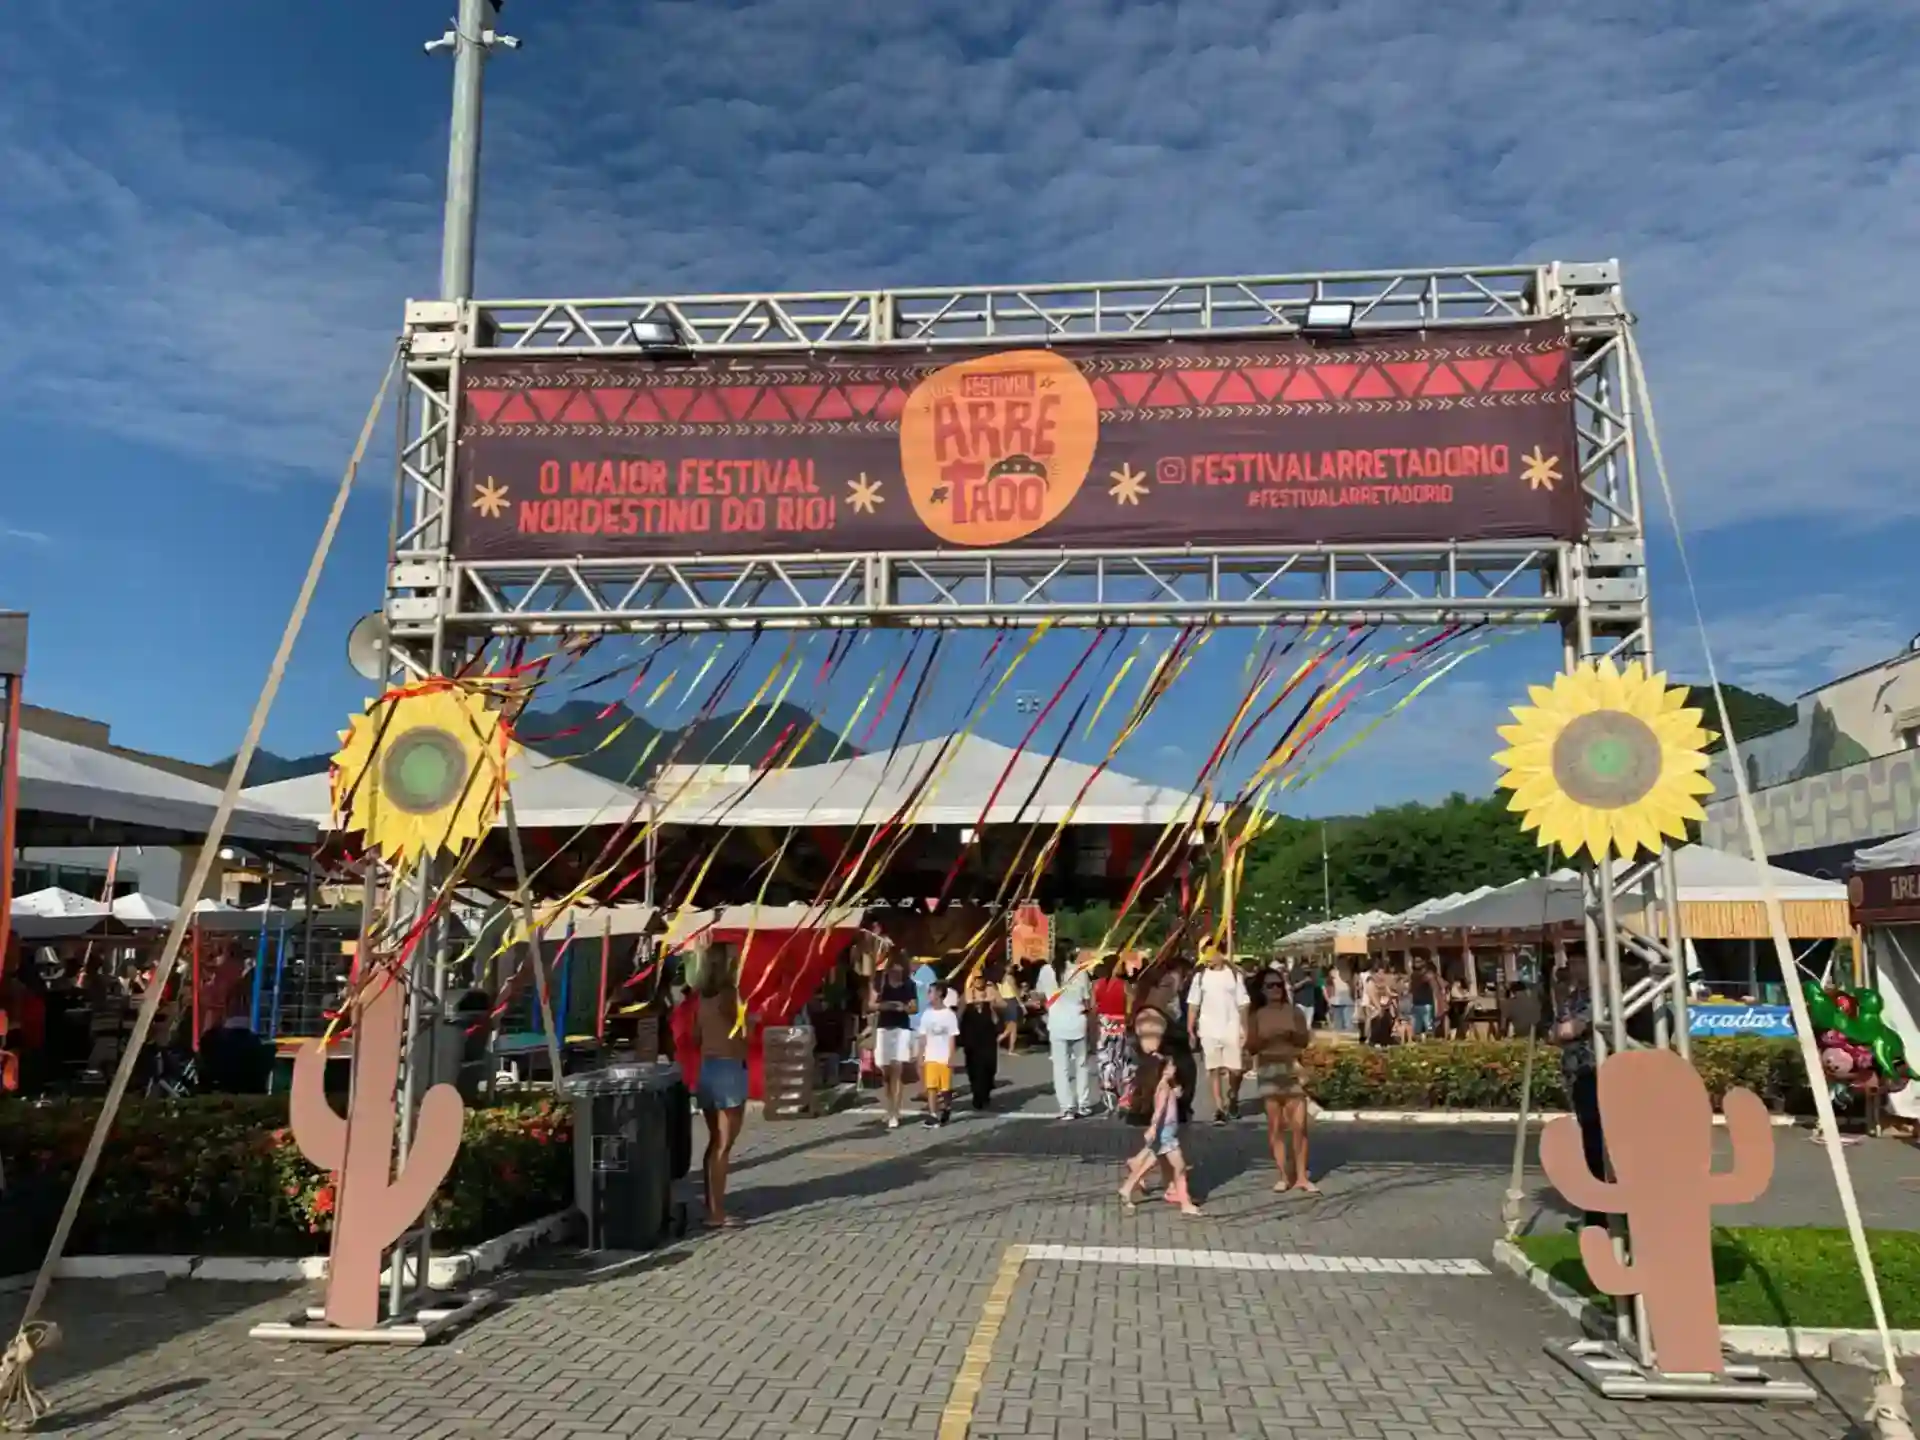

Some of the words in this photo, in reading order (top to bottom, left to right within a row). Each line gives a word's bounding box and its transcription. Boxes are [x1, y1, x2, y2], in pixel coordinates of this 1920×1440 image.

[964, 373, 1030, 397] FESTIVAL
[933, 394, 1061, 461] ARRE
[540, 459, 559, 495] O
[570, 458, 667, 495] MAIOR
[678, 457, 820, 495] FESTIVAL
[1191, 444, 1509, 485] FESTIVALARRETADORIO
[941, 459, 1044, 524] TADO
[1247, 483, 1454, 508] #FESTIVALARRETADORIO
[518, 497, 710, 535] NORDESTINO
[720, 496, 766, 533] DO
[776, 494, 836, 532] RIO!
